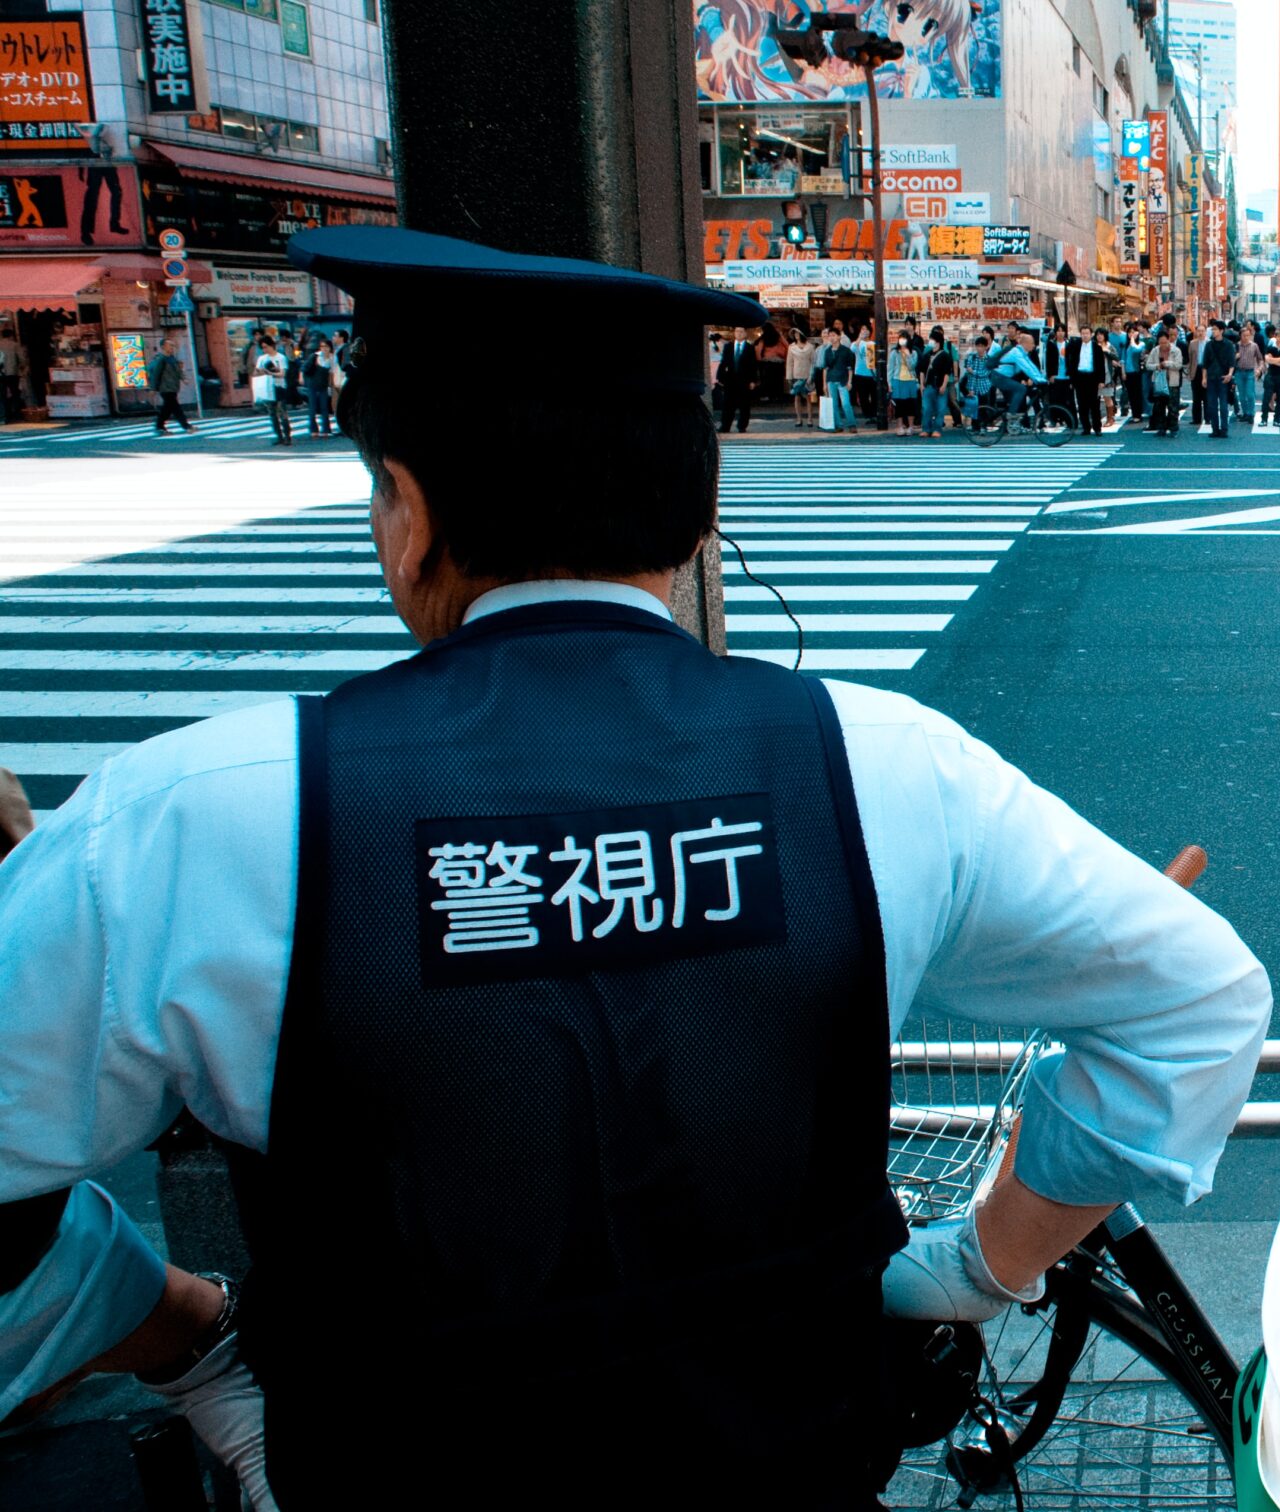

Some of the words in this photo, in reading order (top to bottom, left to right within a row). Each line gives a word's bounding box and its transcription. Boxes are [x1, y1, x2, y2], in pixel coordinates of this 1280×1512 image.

[1150, 119, 1166, 161] KFC
[889, 149, 951, 164] SoftBank
[868, 175, 958, 192] ocomo
[1121, 182, 1138, 263] オヤイデ電気
[165, 234, 180, 246] 20
[829, 218, 909, 260] ONE
[217, 270, 249, 281] Welcome
[251, 271, 279, 284] Foreign
[746, 265, 803, 279] SoftBank
[825, 265, 875, 279] SoftBan
[910, 265, 974, 280] SoftBank
[428, 817, 763, 954] 警視庁
